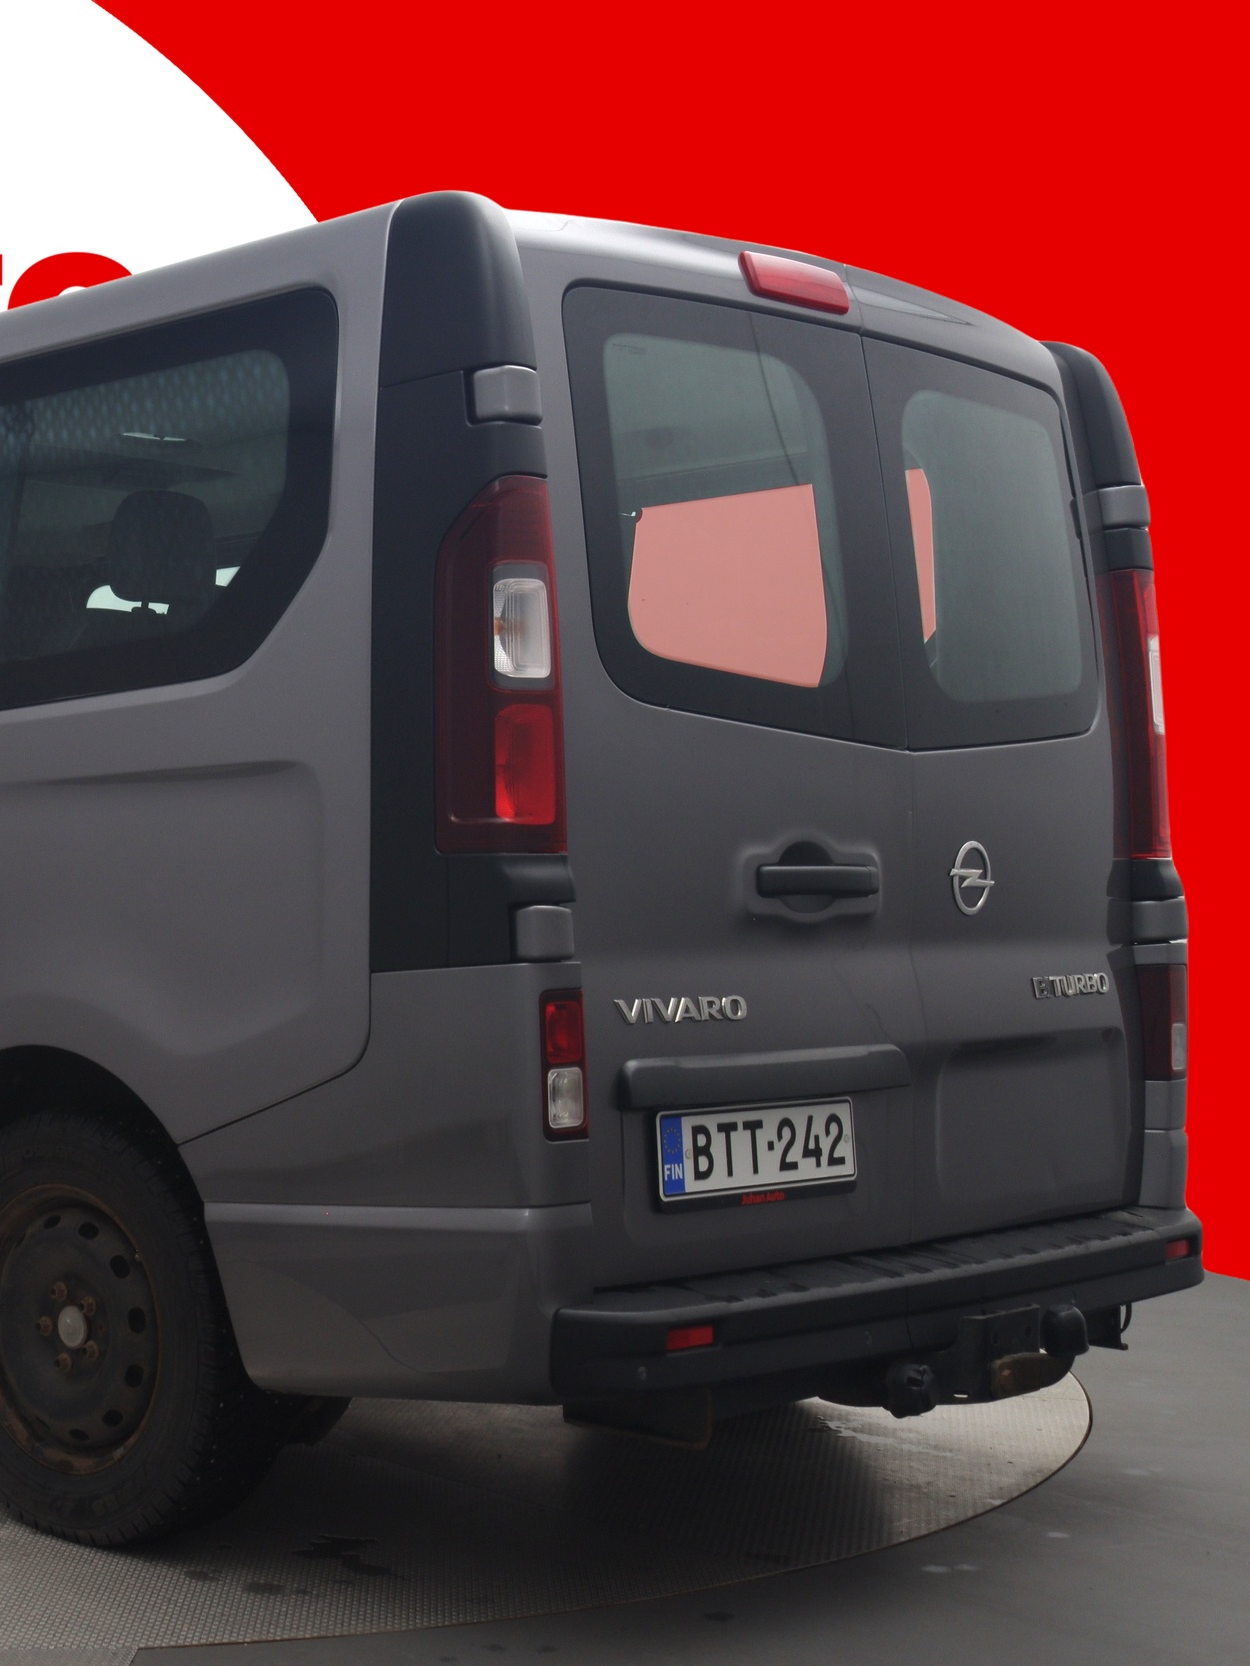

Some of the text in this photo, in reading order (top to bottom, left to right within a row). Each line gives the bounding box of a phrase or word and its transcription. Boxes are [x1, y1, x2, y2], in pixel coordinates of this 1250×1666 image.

[613, 995, 748, 1024] VIVARO
[691, 1113, 846, 1181] BTT-242
[664, 1163, 683, 1181] FIN
[741, 1190, 785, 1206] Juhan Auto
